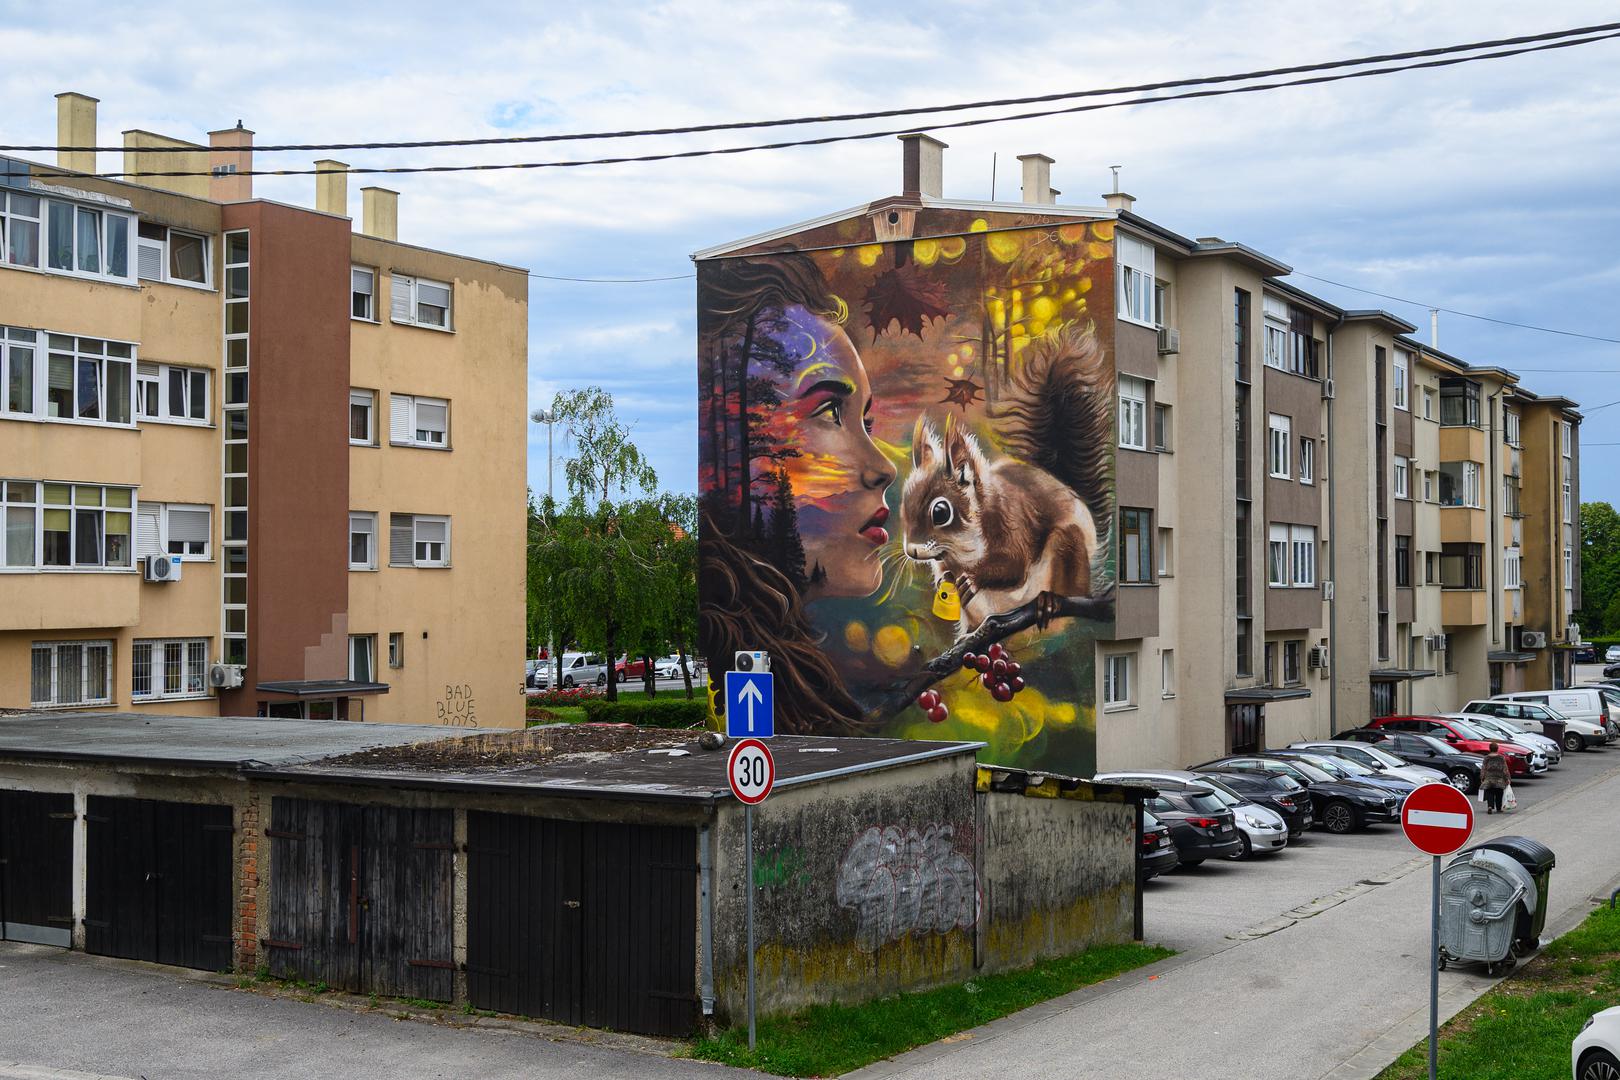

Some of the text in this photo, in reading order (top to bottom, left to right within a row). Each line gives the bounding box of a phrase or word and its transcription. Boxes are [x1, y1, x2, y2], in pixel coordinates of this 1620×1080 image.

[445, 684, 472, 700] BAD
[436, 699, 475, 719] BLUE
[739, 756, 764, 787] 30
